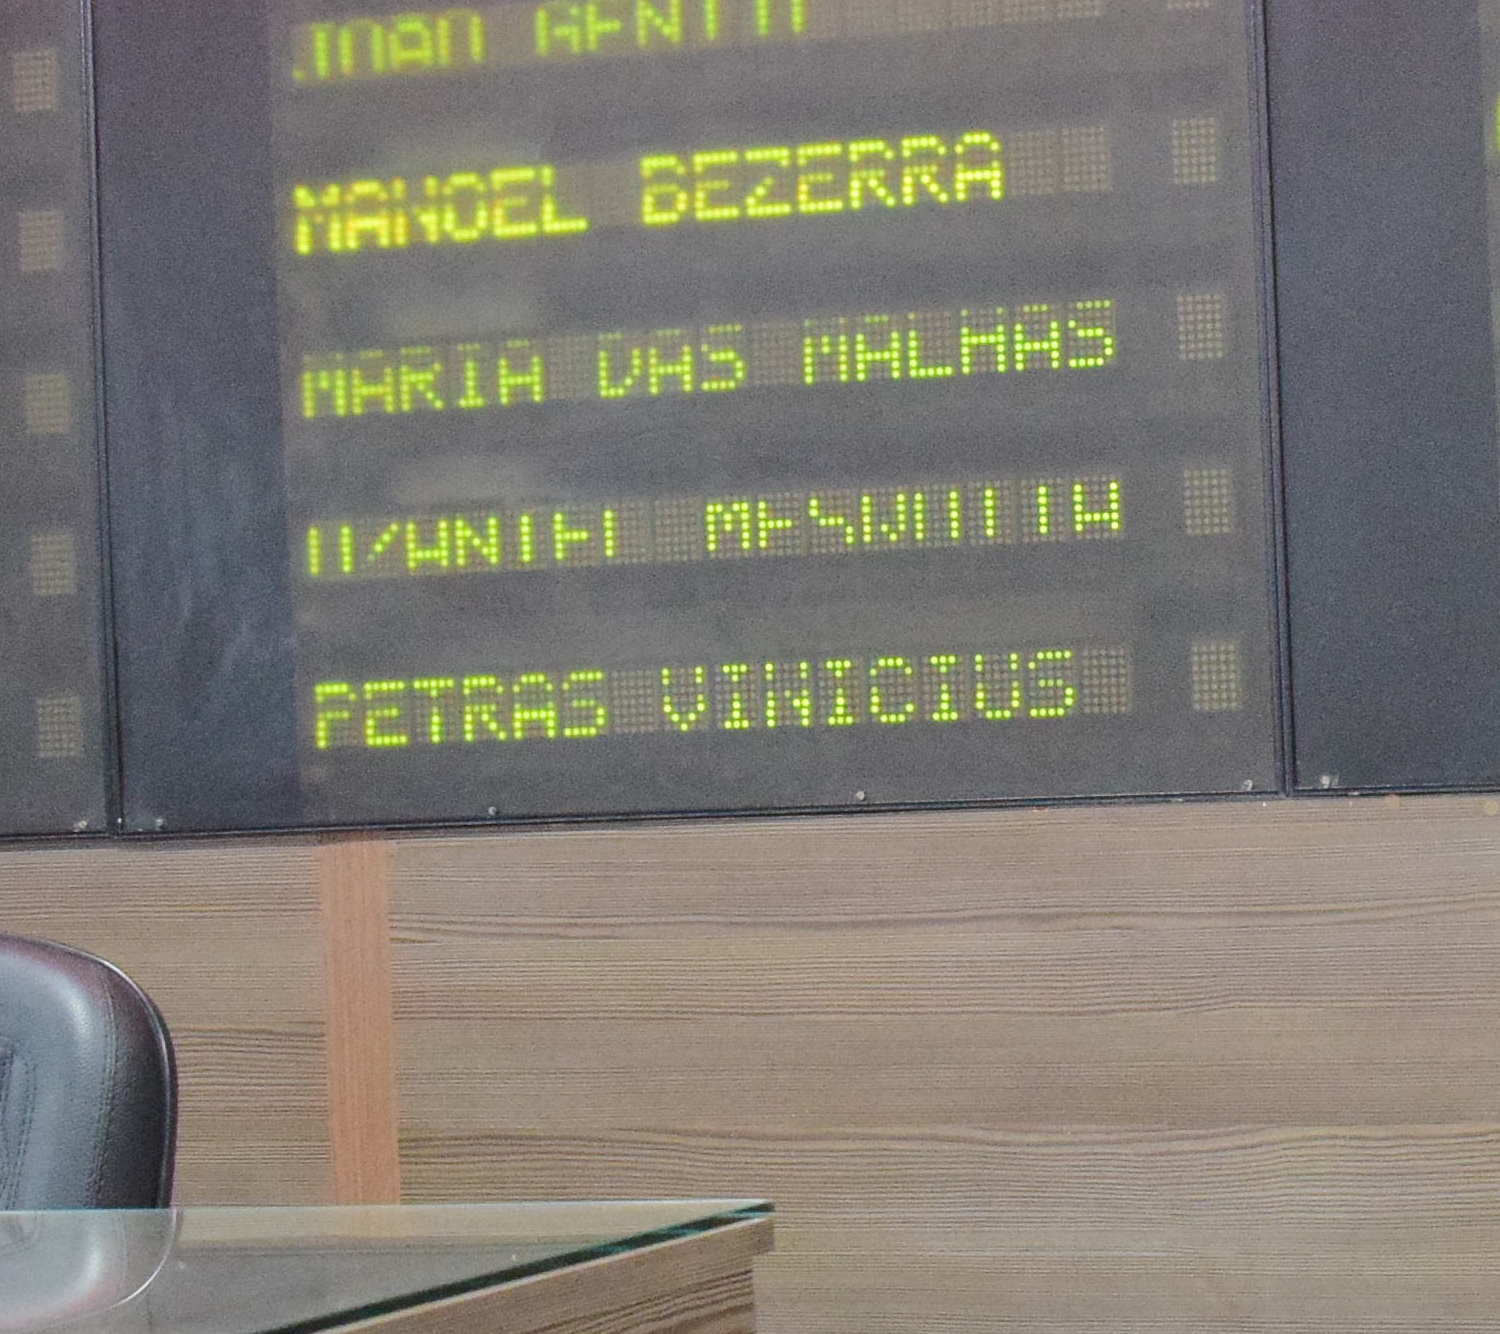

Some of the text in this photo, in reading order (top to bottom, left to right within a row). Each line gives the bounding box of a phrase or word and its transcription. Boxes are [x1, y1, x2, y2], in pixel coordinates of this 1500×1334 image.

[293, 131, 1003, 255] MANOEL BEZERRA
[315, 652, 1074, 747] PETRAS VINICIUS
